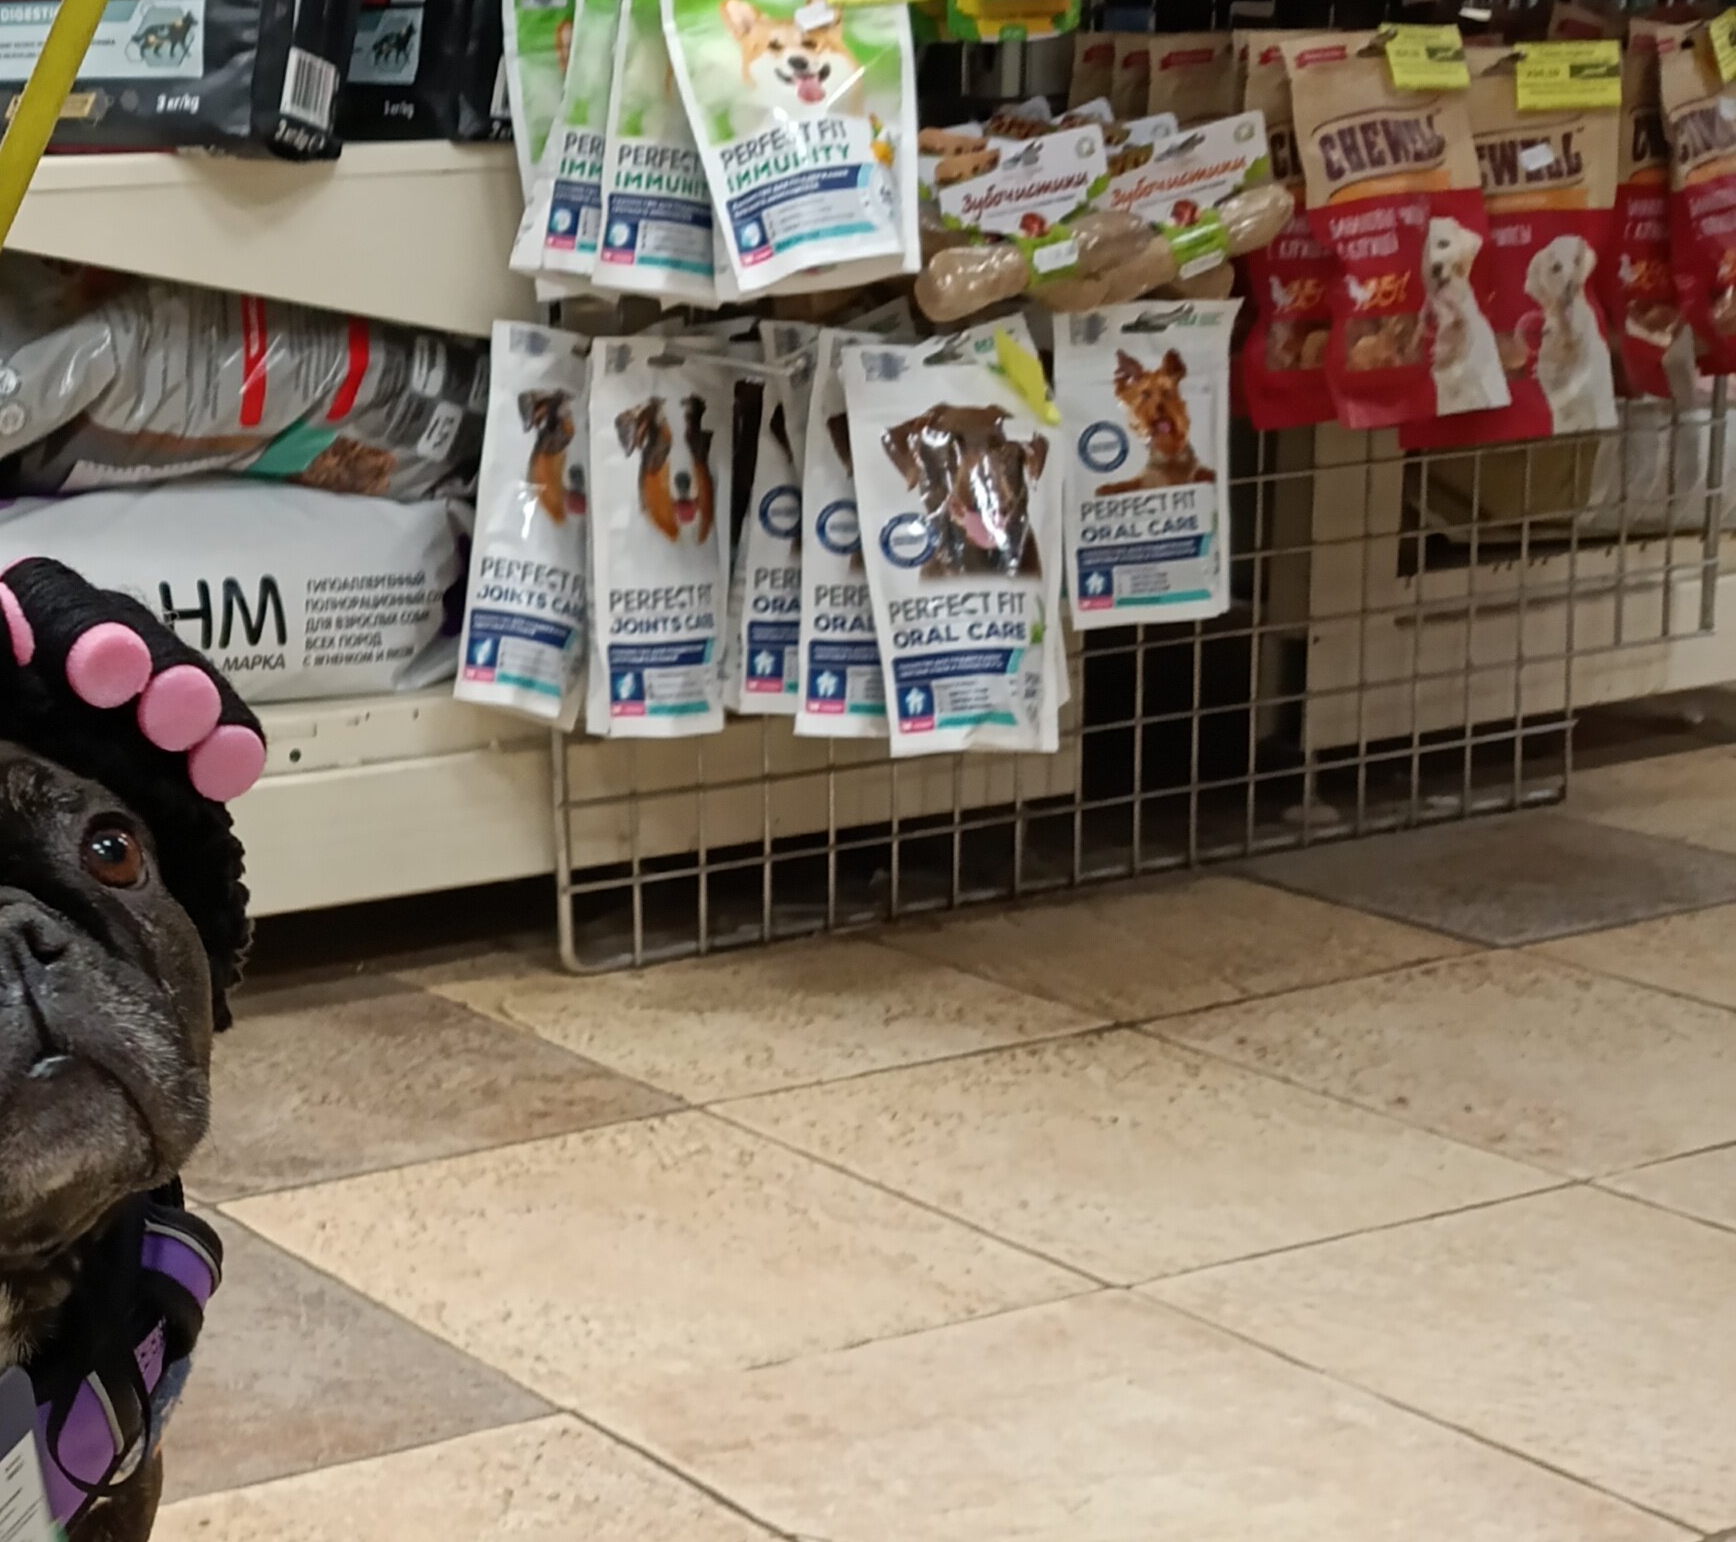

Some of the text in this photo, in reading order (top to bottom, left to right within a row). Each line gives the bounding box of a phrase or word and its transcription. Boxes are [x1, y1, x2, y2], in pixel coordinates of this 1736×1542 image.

[564, 131, 606, 156] PER
[720, 118, 848, 171] PERFET FIT
[961, 171, 1090, 221] Зубочистики
[1110, 155, 1247, 210] Зубочистики
[1080, 489, 1196, 523] PERFECT FIT
[1080, 514, 1200, 544] ORAL CARE
[480, 556, 569, 593] PERFECT
[476, 583, 548, 610] JOINTS
[609, 584, 688, 614] PERFECT
[752, 595, 802, 615] ORA
[814, 584, 872, 609] PERF
[888, 590, 1027, 626] PERFECT FIT
[305, 616, 333, 635] ДЛЯ
[305, 630, 383, 651] ВСЕХ ПОРОД
[609, 616, 682, 636] JOINTS
[892, 619, 1028, 650] ORAL CARE
[221, 653, 286, 672] МАРКА
